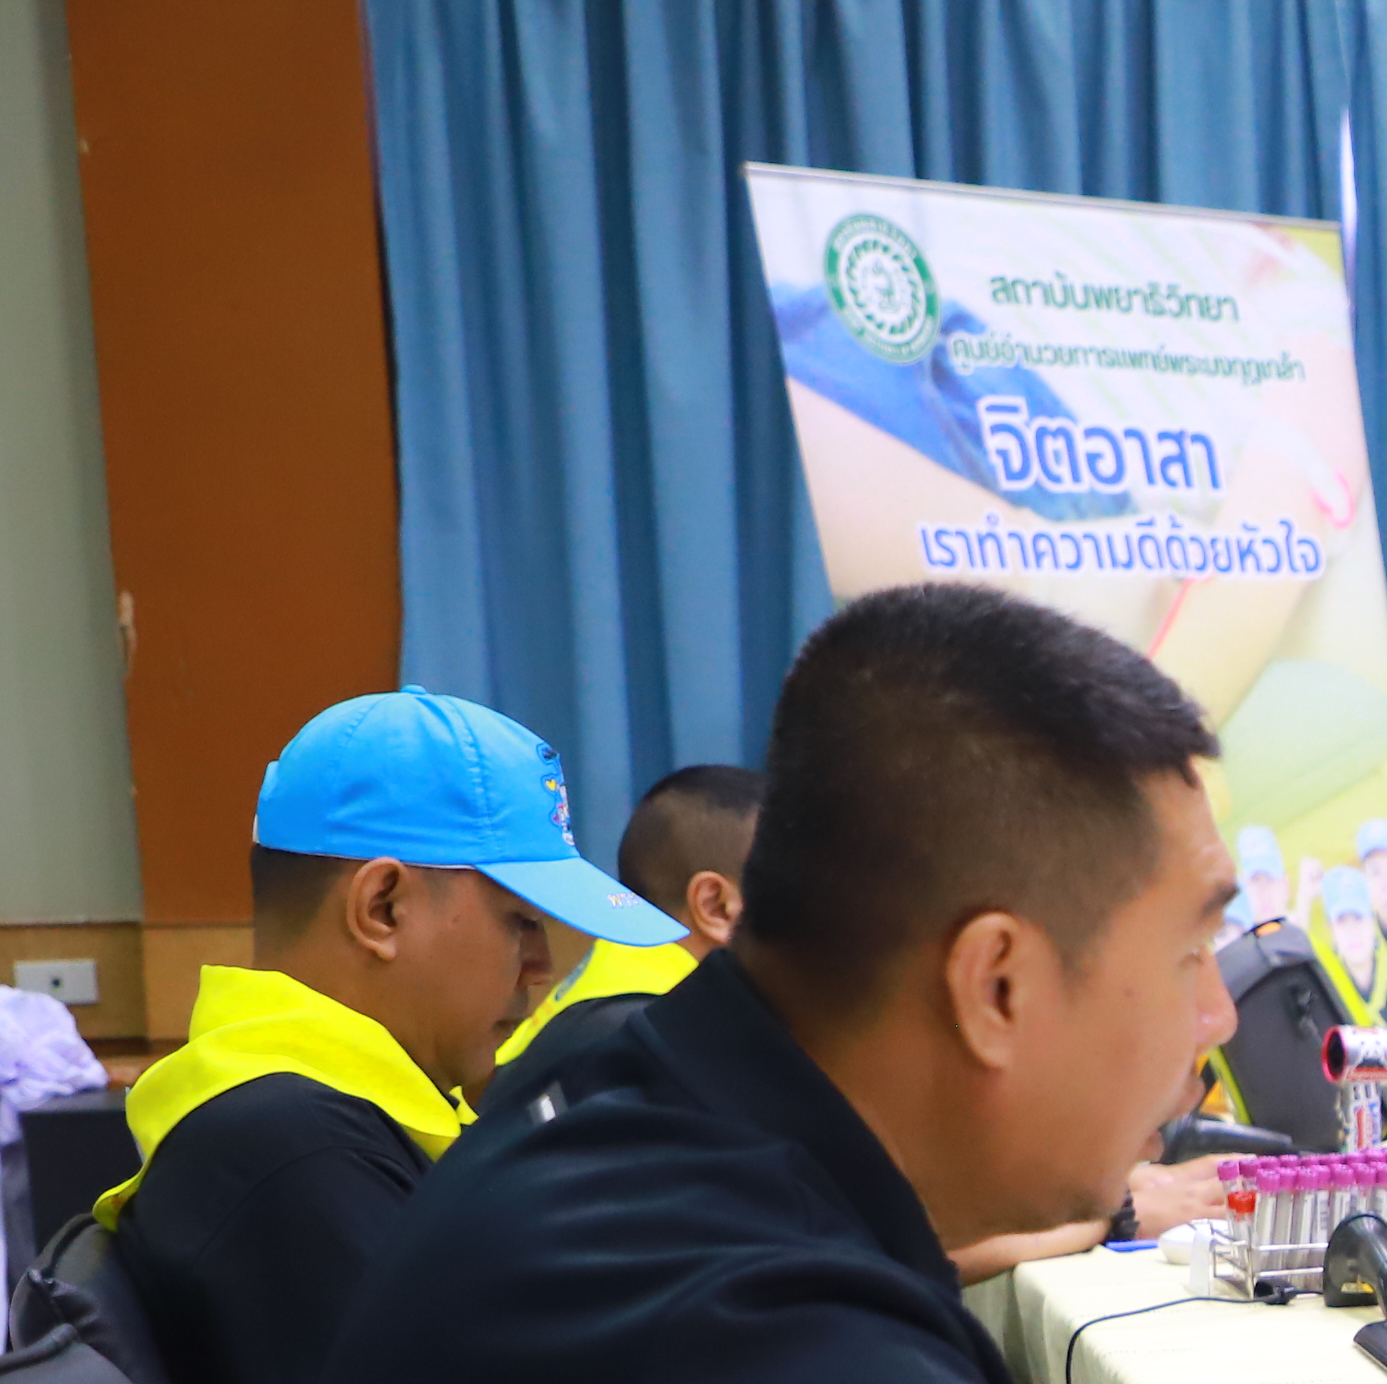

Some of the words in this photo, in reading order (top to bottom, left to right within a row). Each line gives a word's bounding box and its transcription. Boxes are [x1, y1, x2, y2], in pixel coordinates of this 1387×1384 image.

[990, 272, 1239, 324] สถาบันพยาธิวิทยา
[984, 401, 1222, 491] จิตอาสา
[920, 513, 1326, 579] เราทำความดีด้วยหัวใจ
